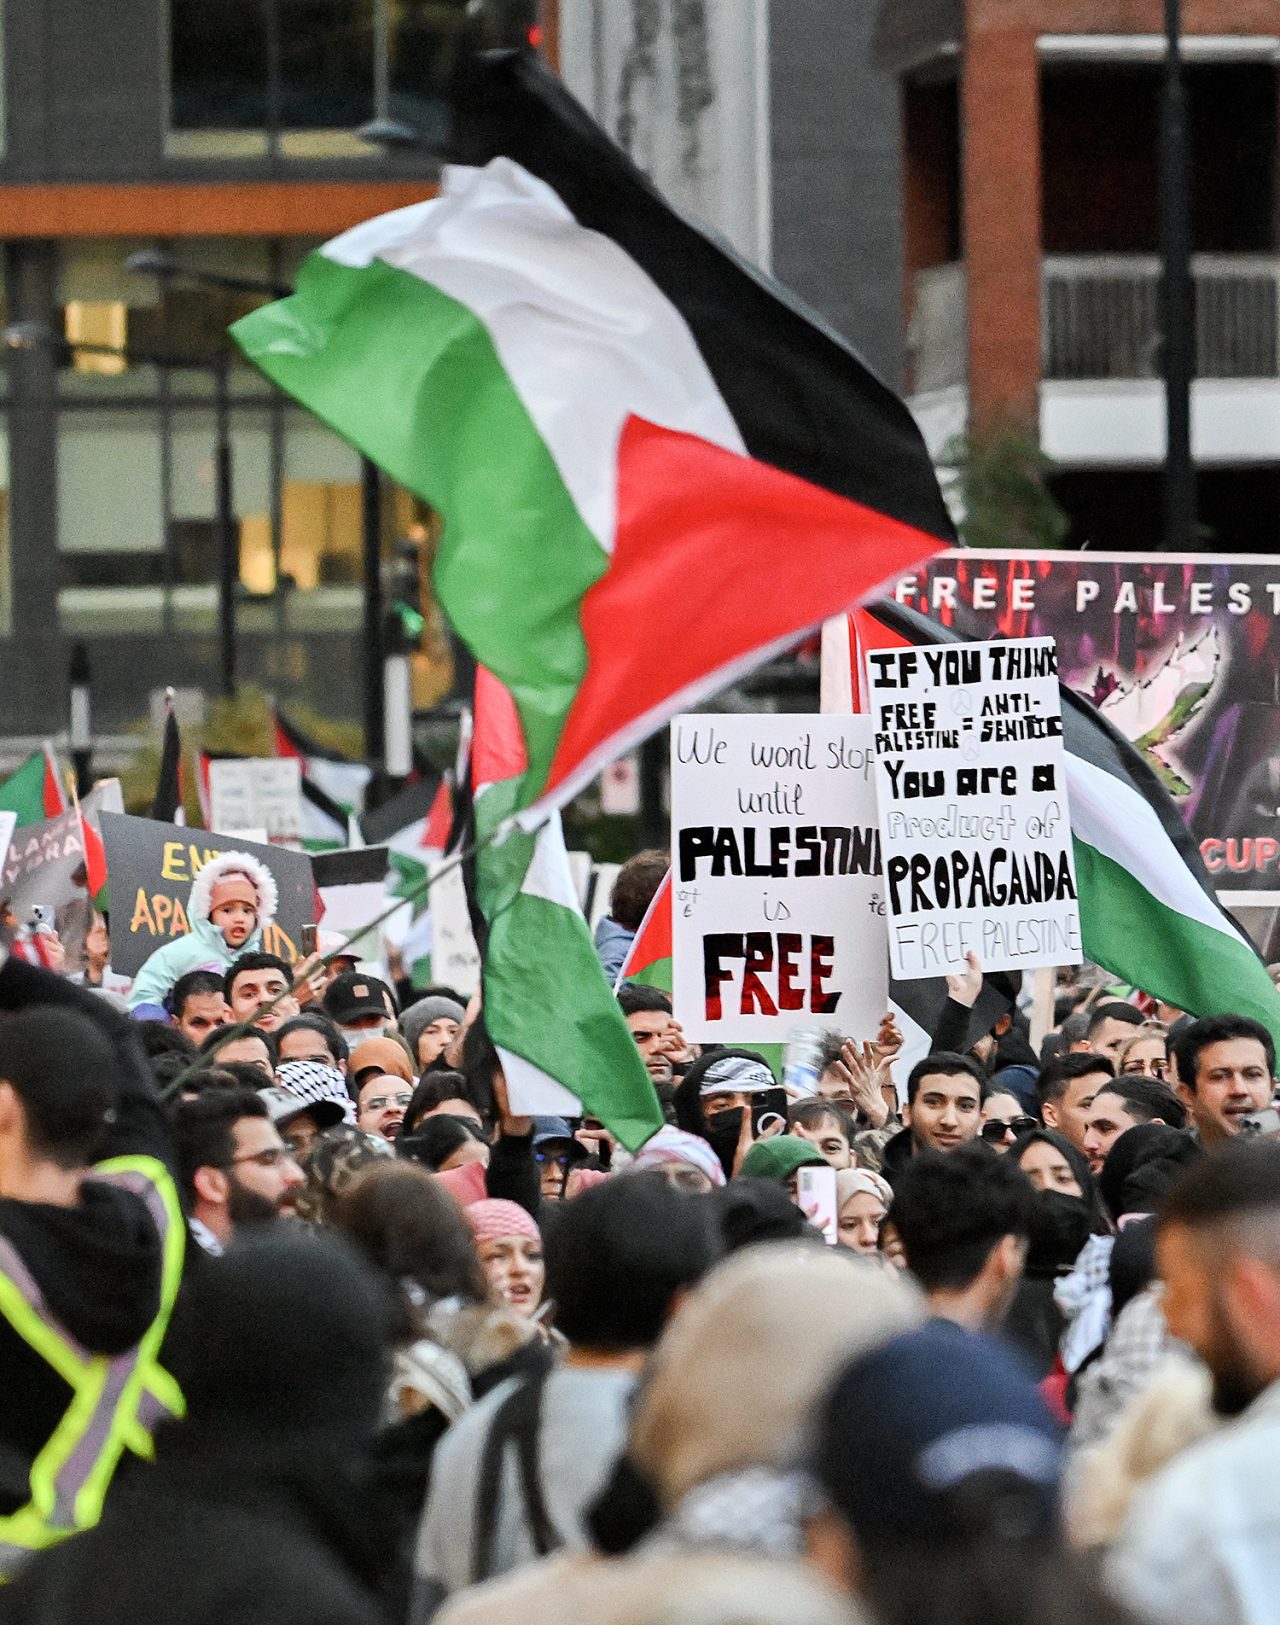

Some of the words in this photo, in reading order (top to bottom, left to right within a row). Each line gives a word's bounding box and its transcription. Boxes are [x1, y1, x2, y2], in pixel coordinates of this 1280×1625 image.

[895, 577, 1035, 610] FREE
[870, 652, 918, 688] IF
[924, 650, 981, 687] YOU
[989, 646, 1059, 681] THINK
[881, 703, 937, 731] FREE
[980, 693, 1041, 717] ANTI-
[677, 725, 728, 765] We
[751, 733, 817, 770] won't
[874, 730, 960, 755] PALESTINE
[737, 781, 806, 815] until
[883, 760, 945, 799] You
[956, 766, 1017, 796] are
[1031, 763, 1056, 792] a
[887, 804, 1017, 841] Product
[1025, 801, 1061, 840] of
[161, 842, 221, 882] EN
[887, 847, 1078, 916] PROPAGANDA
[130, 886, 299, 965] APAID
[763, 892, 792, 921] is
[895, 921, 975, 970] FREE
[983, 913, 1083, 960] PALESTINE
[703, 931, 842, 1021] FREE
